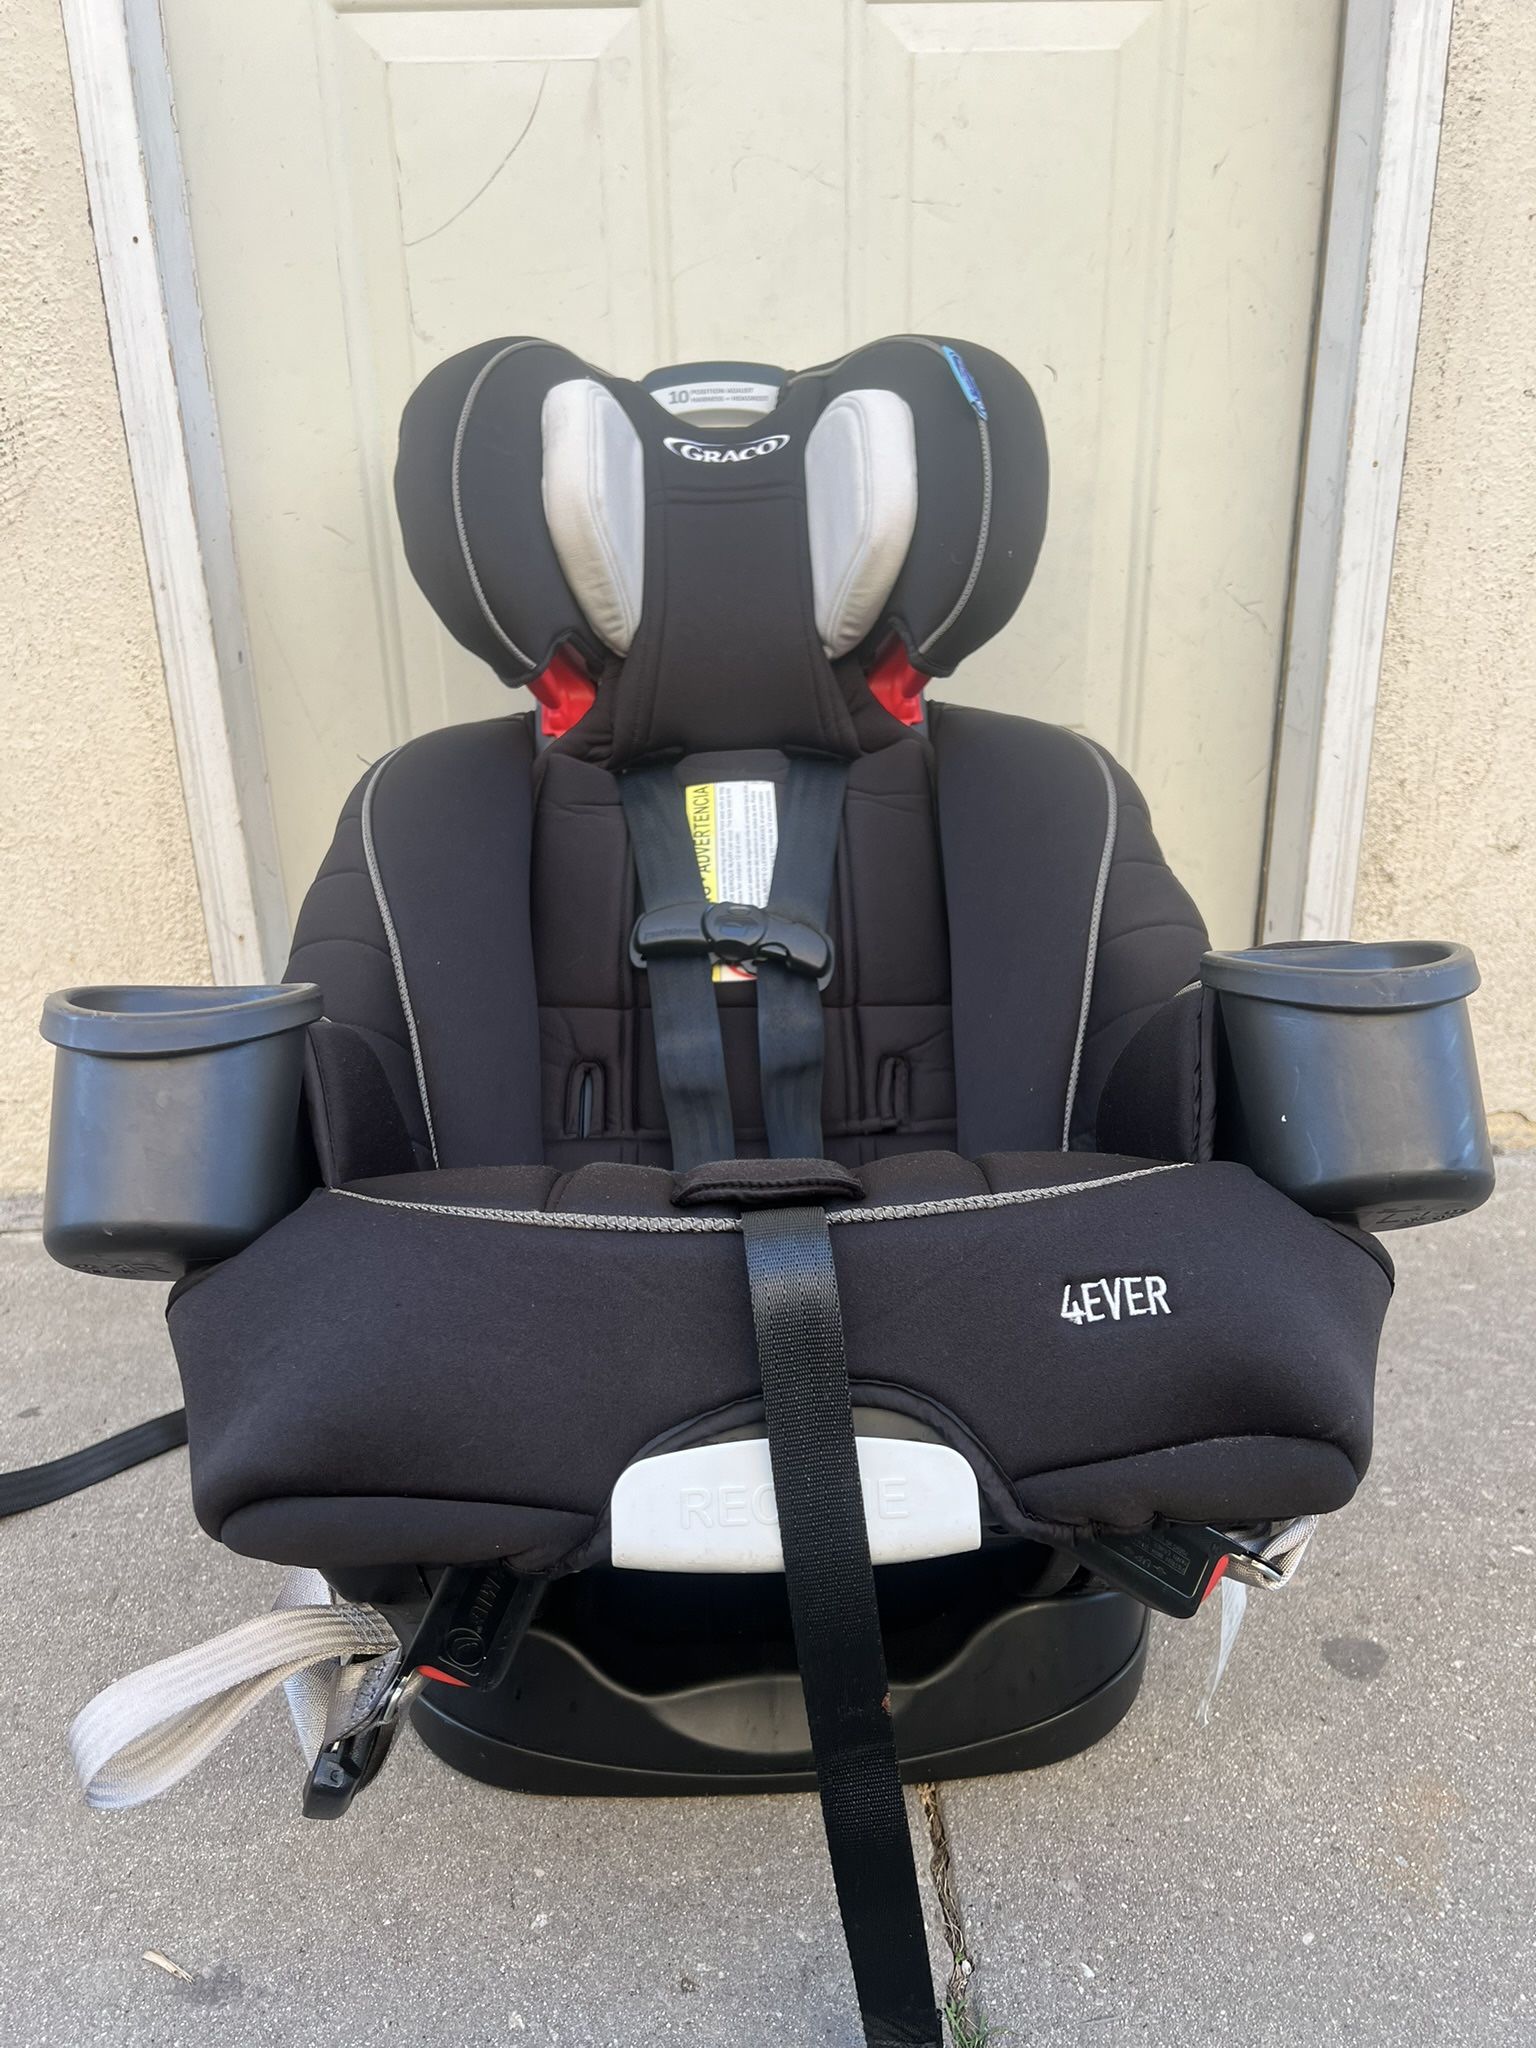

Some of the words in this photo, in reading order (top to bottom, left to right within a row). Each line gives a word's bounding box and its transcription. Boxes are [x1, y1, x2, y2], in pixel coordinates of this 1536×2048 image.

[669, 390, 689, 404] 10
[679, 437, 779, 463] GRACO
[693, 786, 711, 873] ADVERTENCIA
[1061, 1276, 1171, 1325] 4EVER
[679, 1476, 911, 1529] RECE
